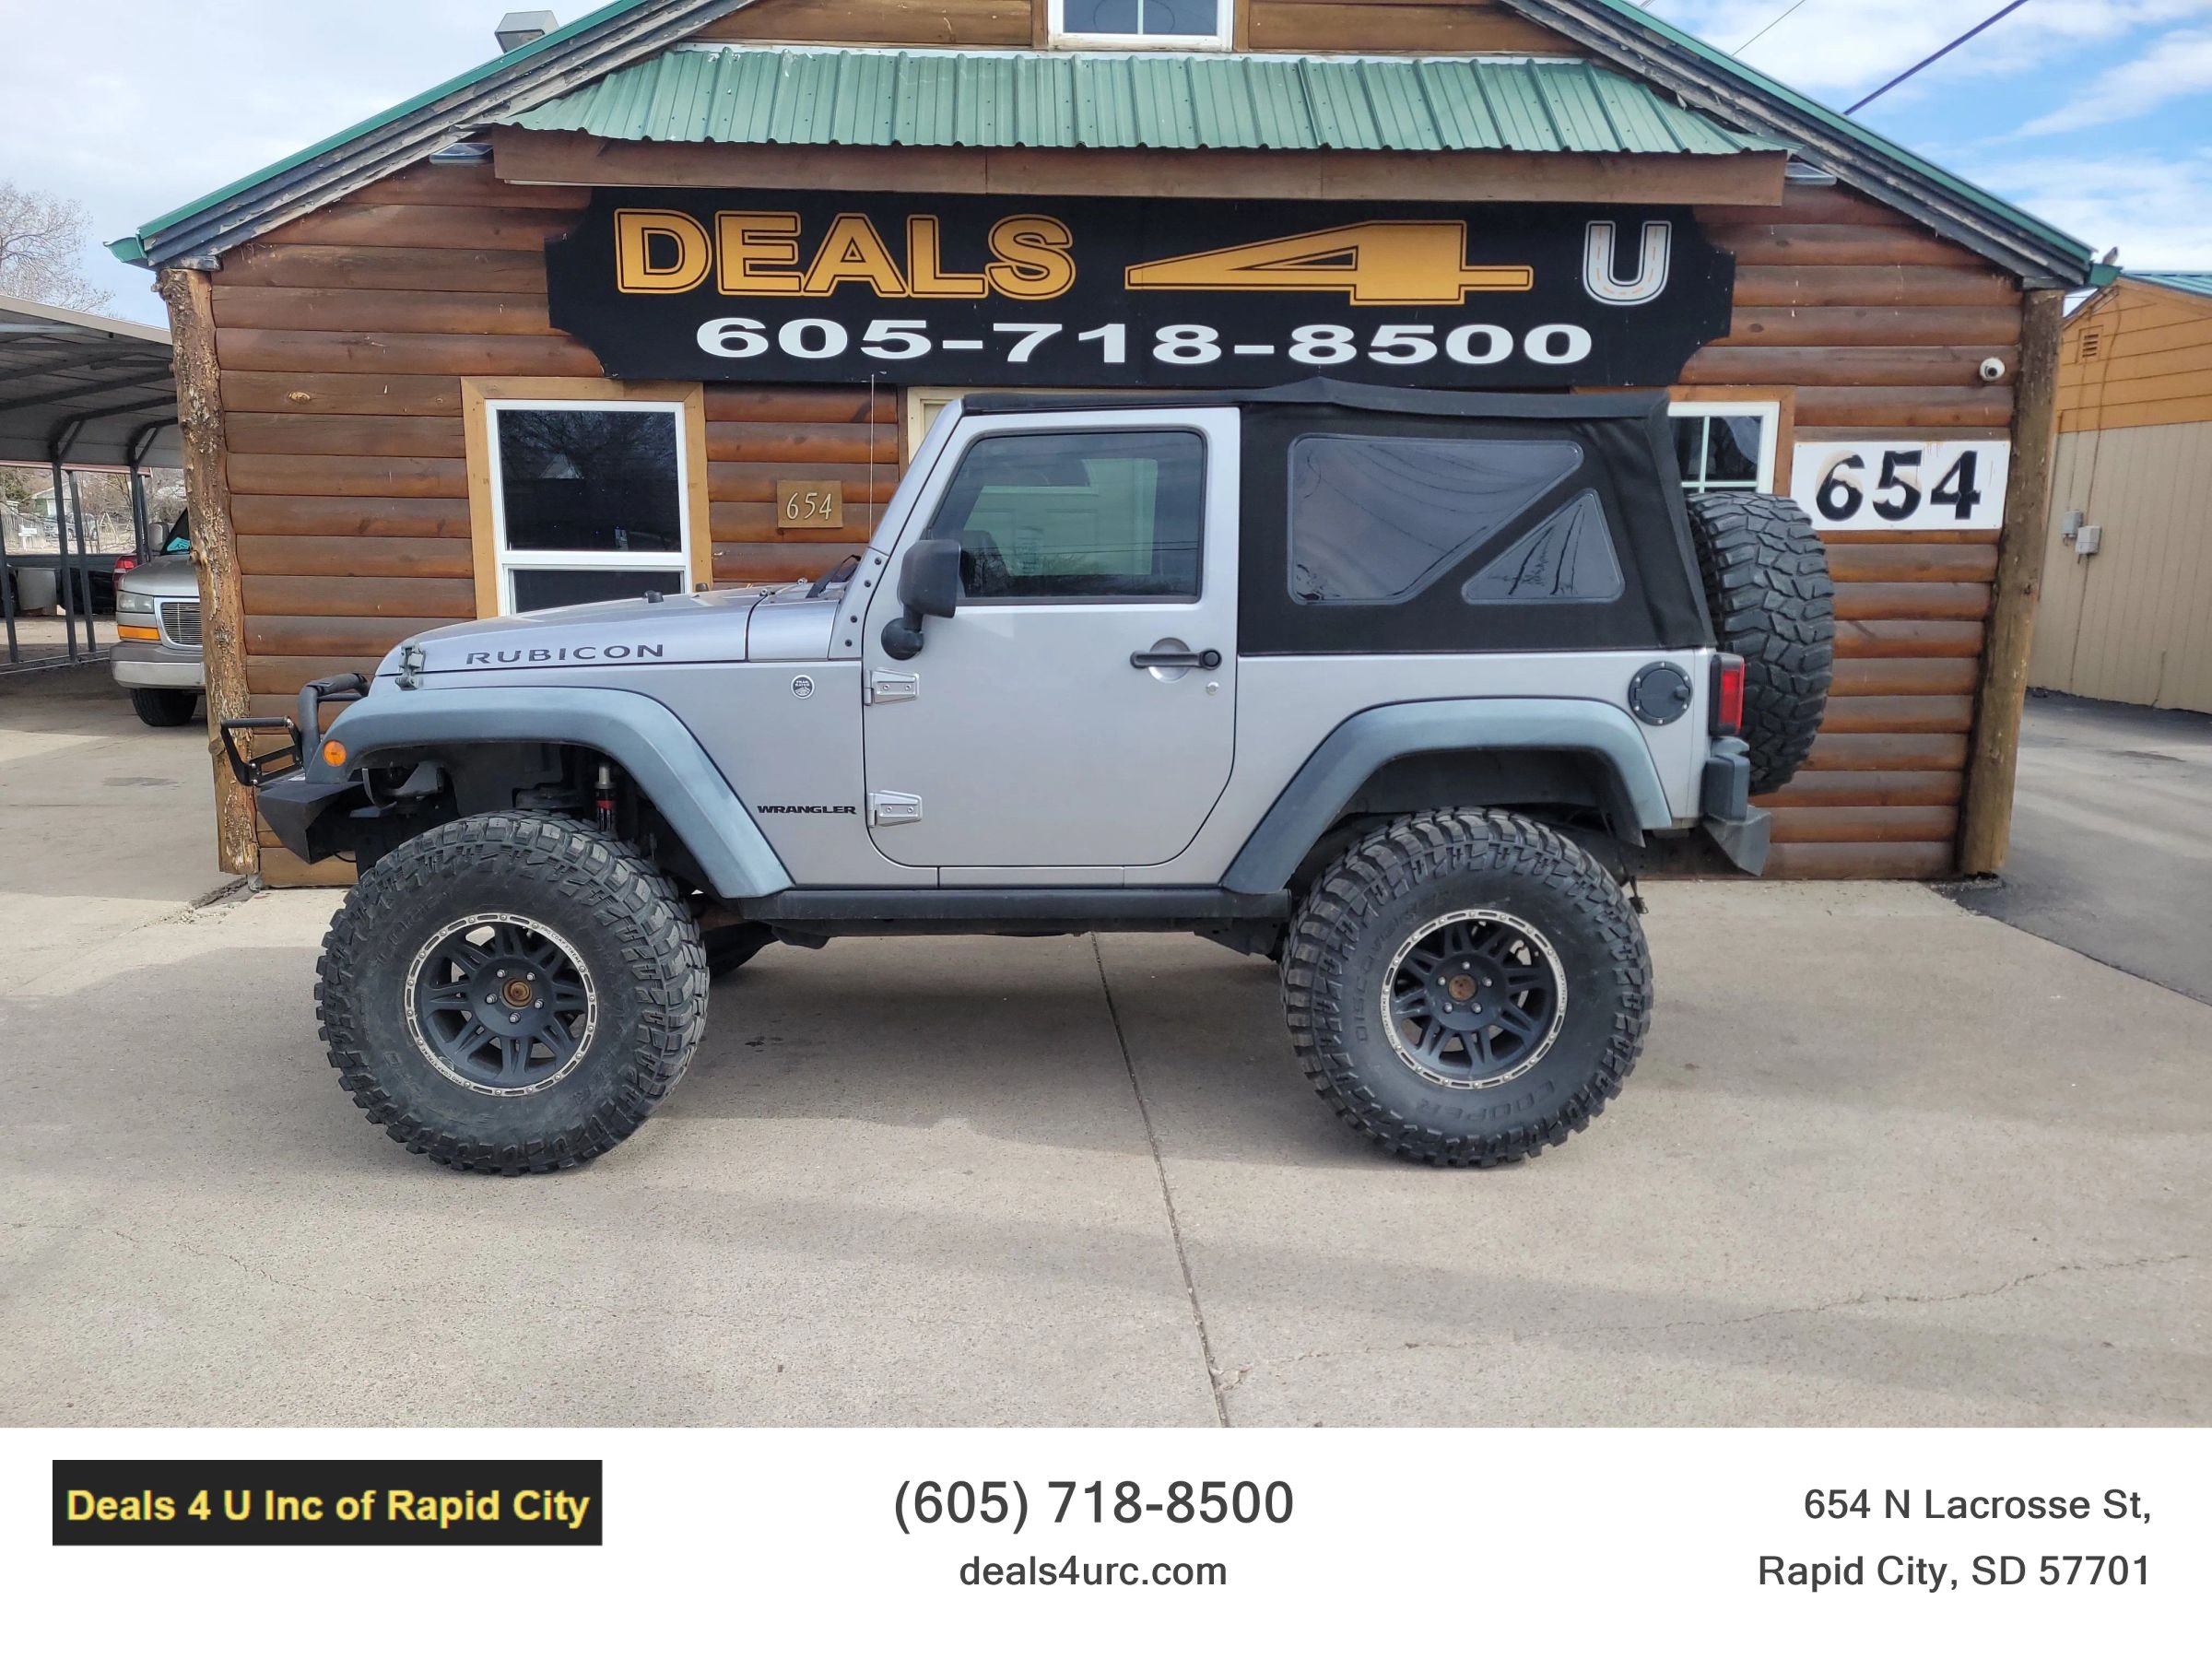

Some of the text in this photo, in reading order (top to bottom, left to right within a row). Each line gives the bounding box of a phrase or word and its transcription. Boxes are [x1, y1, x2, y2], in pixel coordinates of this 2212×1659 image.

[614, 208, 1672, 305] DEALS 4 U
[697, 317, 1592, 365] 605-718-8500
[1816, 449, 1982, 522] 654
[786, 491, 832, 520] 654
[466, 643, 663, 665] RUBICON
[758, 806, 856, 815] WRANGLER
